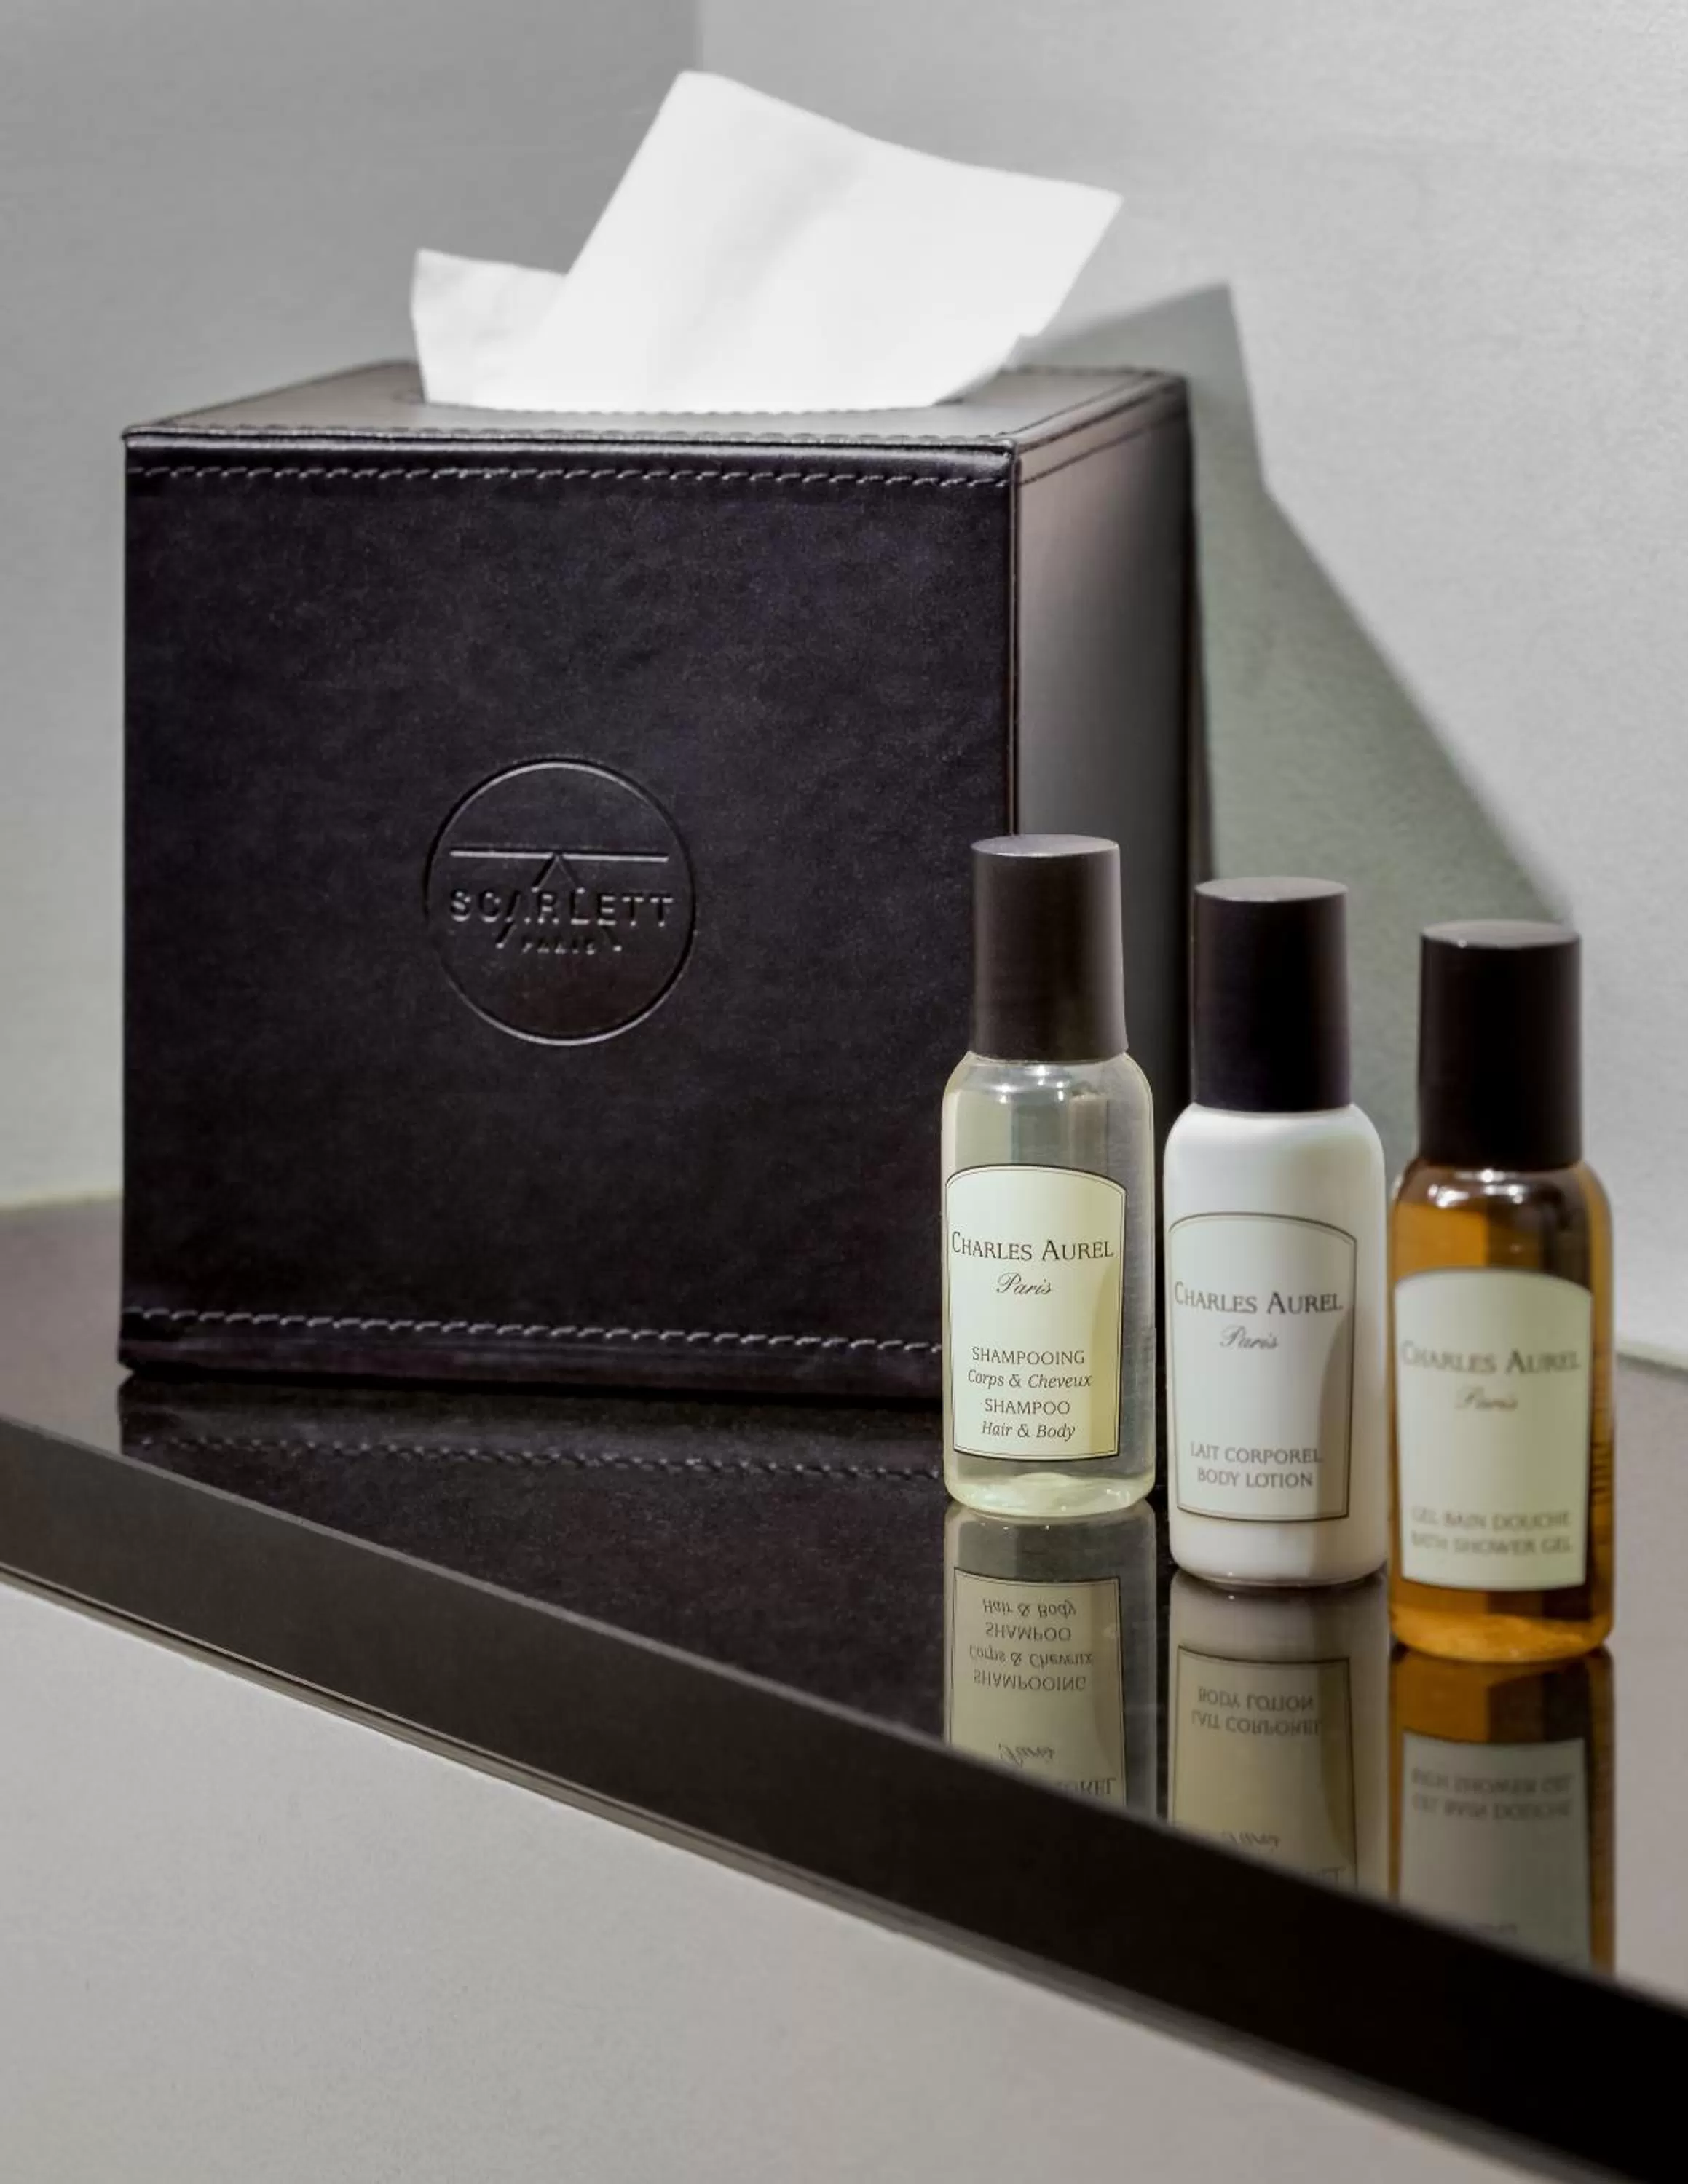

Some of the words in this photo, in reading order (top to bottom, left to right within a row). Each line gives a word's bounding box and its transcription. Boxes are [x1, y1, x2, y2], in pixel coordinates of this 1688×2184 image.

[951, 1231, 1033, 1261] CHARLES
[1041, 1240, 1115, 1261] AUREL
[996, 1272, 1052, 1295] Paris
[1175, 1281, 1258, 1314] CHARLES
[1266, 1291, 1344, 1314] AUREL
[1220, 1324, 1278, 1349] Paris
[971, 1347, 1085, 1365] SHAMPOOING
[968, 1369, 1004, 1390] Corps
[1009, 1374, 1021, 1388] &
[1028, 1374, 1093, 1388] Cheveux
[984, 1398, 1071, 1415] SHAMPOO
[981, 1421, 1013, 1436] Hair
[1017, 1423, 1030, 1438] &
[1036, 1423, 1076, 1442] Body
[1190, 1441, 1220, 1461] LAIT
[1224, 1447, 1323, 1465] CORPOREL
[1197, 1467, 1240, 1487] BODY
[1245, 1472, 1314, 1489] LOTION
